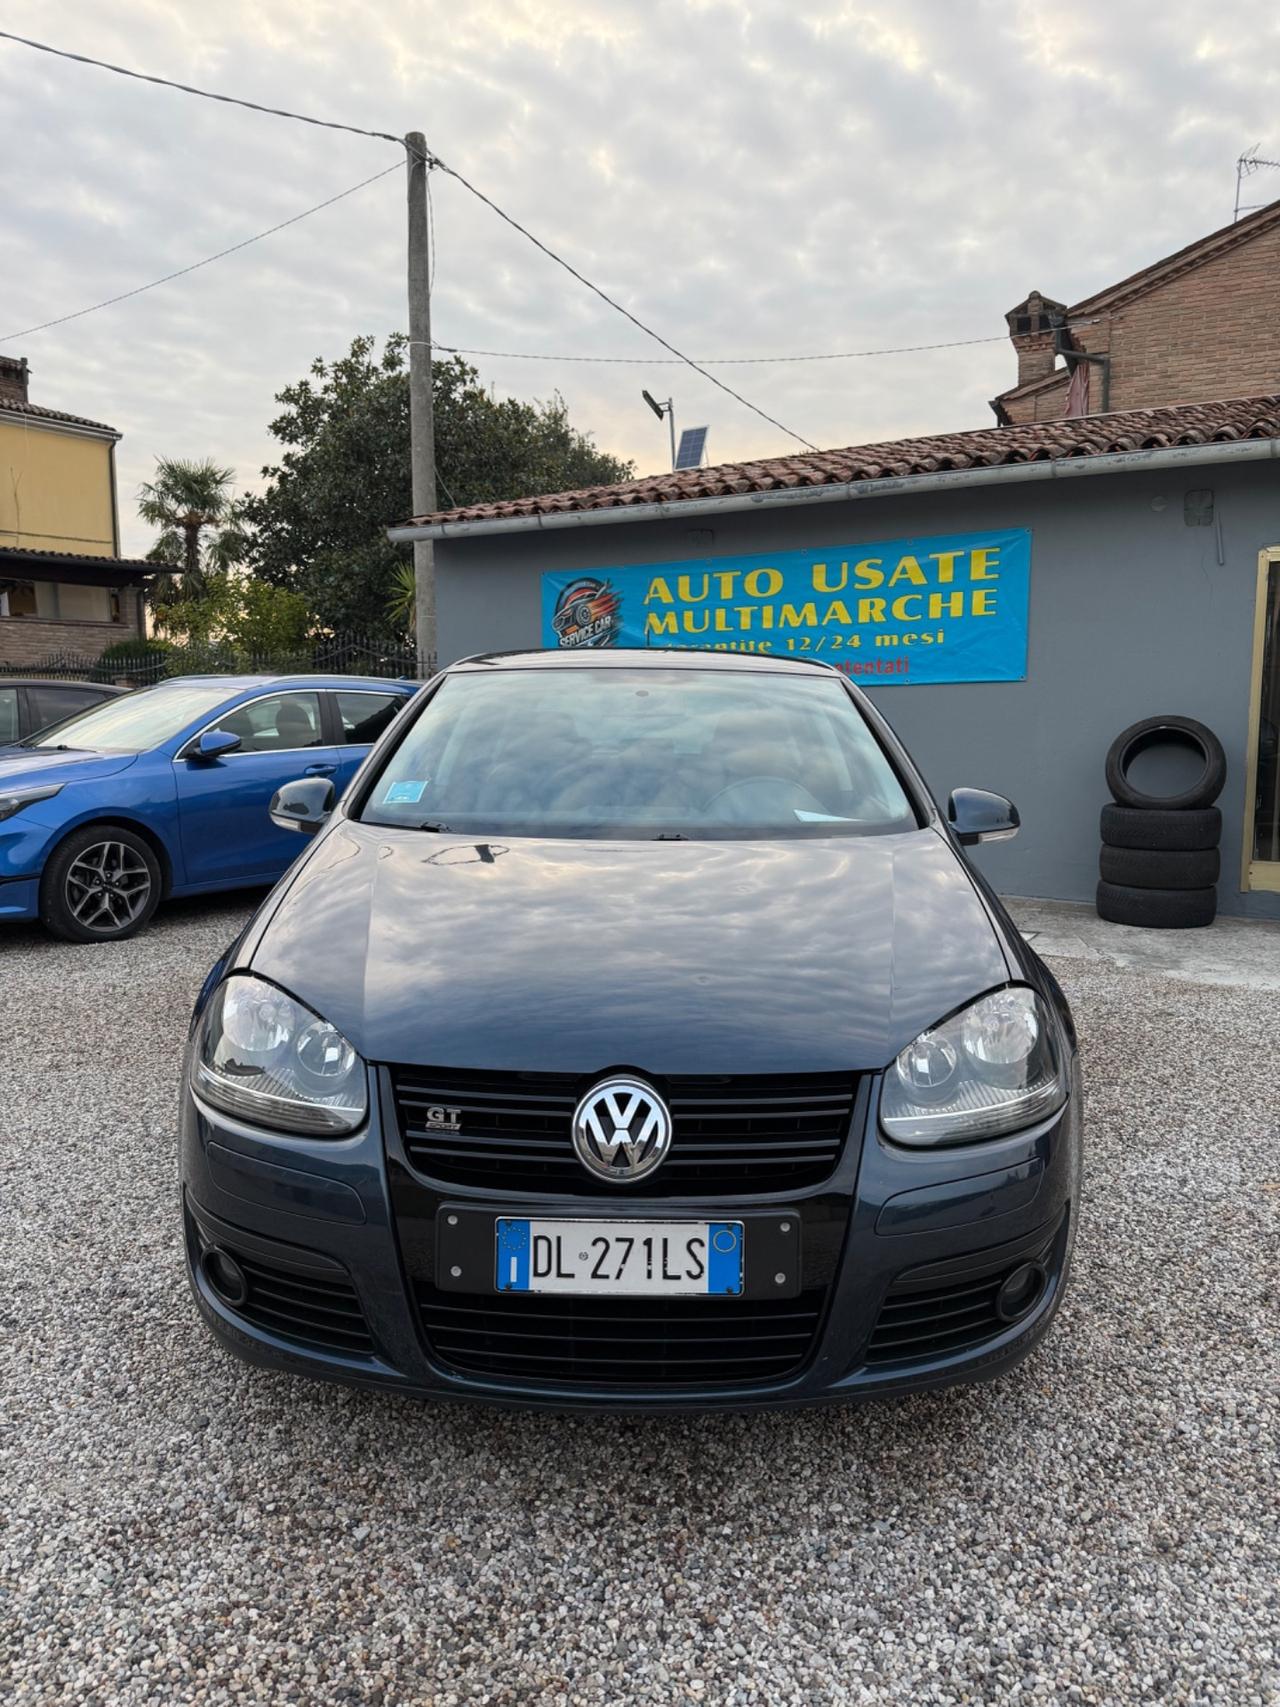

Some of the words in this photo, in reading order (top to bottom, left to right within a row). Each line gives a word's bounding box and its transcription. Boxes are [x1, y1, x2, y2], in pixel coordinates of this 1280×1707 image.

[643, 567, 784, 605] AUTO
[811, 547, 1000, 593] USATE
[560, 624, 594, 646] SERVICE
[595, 615, 611, 632] CAR
[644, 588, 997, 635] MULTIMARCHE
[786, 634, 861, 652] 12/24
[875, 629, 944, 646] mesi
[427, 1107, 461, 1123] GT
[532, 1235, 575, 1279] DL
[590, 1237, 705, 1281] 271LS
